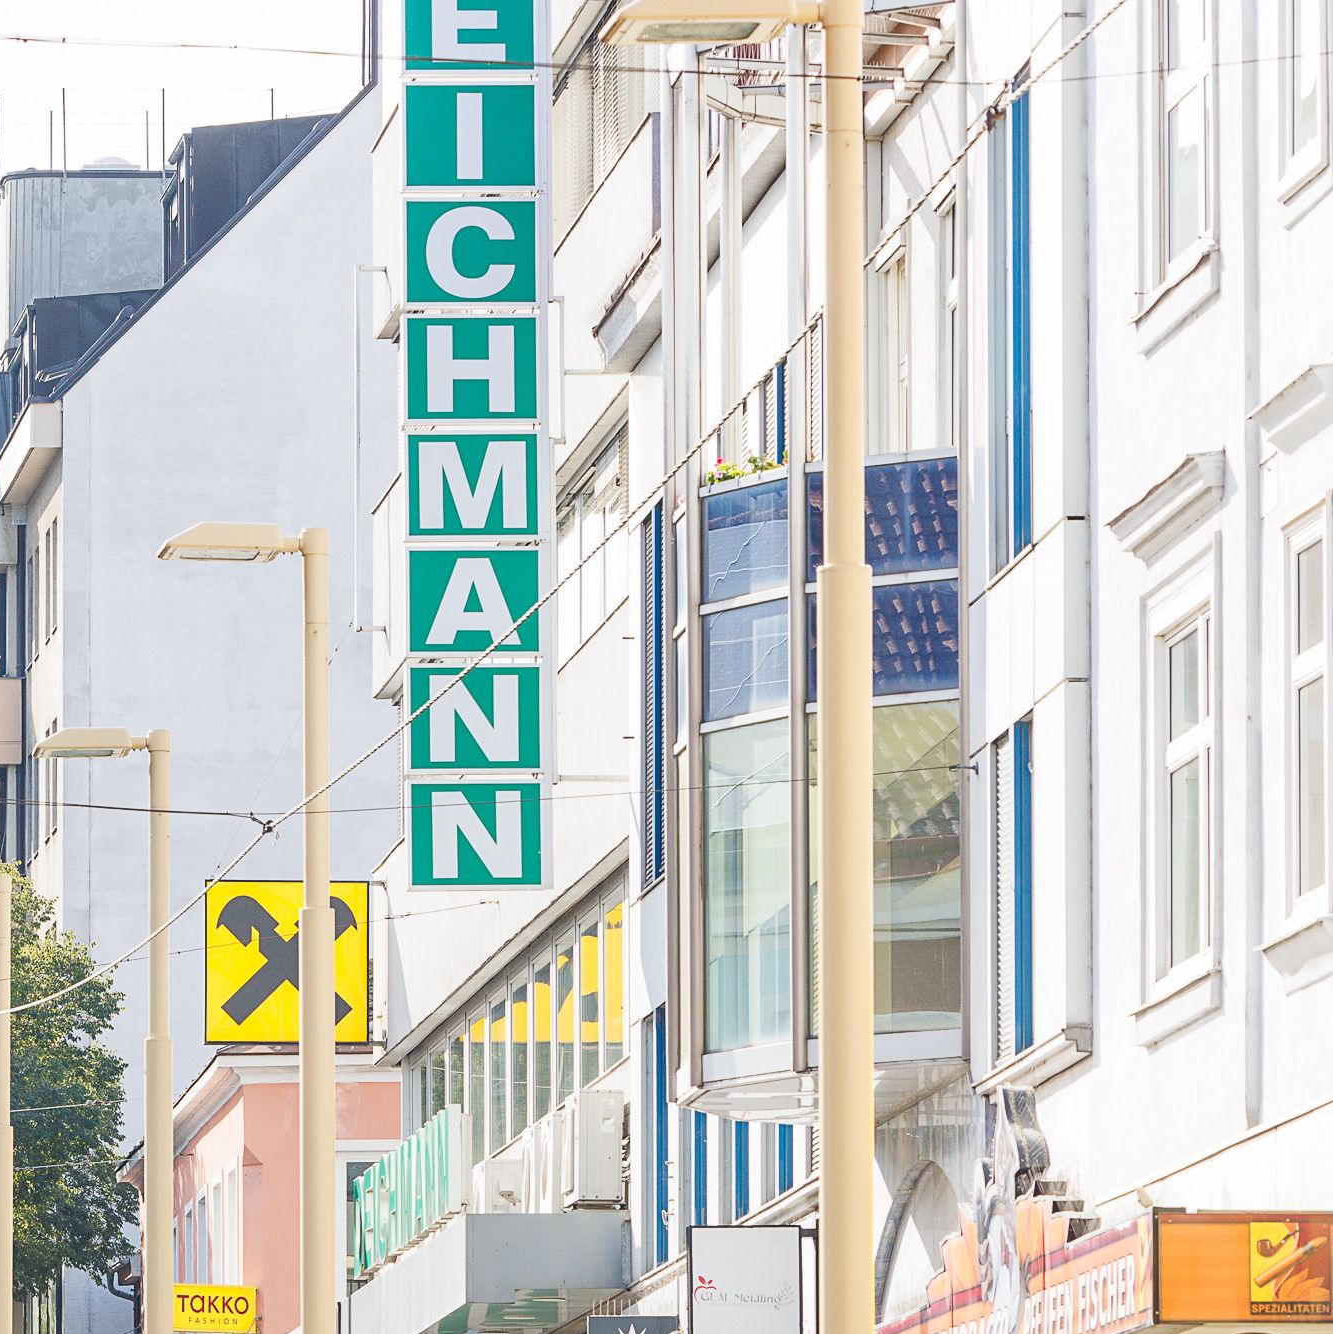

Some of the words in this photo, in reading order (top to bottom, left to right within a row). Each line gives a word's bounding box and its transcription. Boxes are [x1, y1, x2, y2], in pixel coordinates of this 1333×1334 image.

[418, 0, 528, 879] EICHMANN
[353, 1103, 450, 1280] DEICHMANN
[189, 1317, 238, 1325] FASHION
[1078, 1254, 1135, 1334] FISCHER
